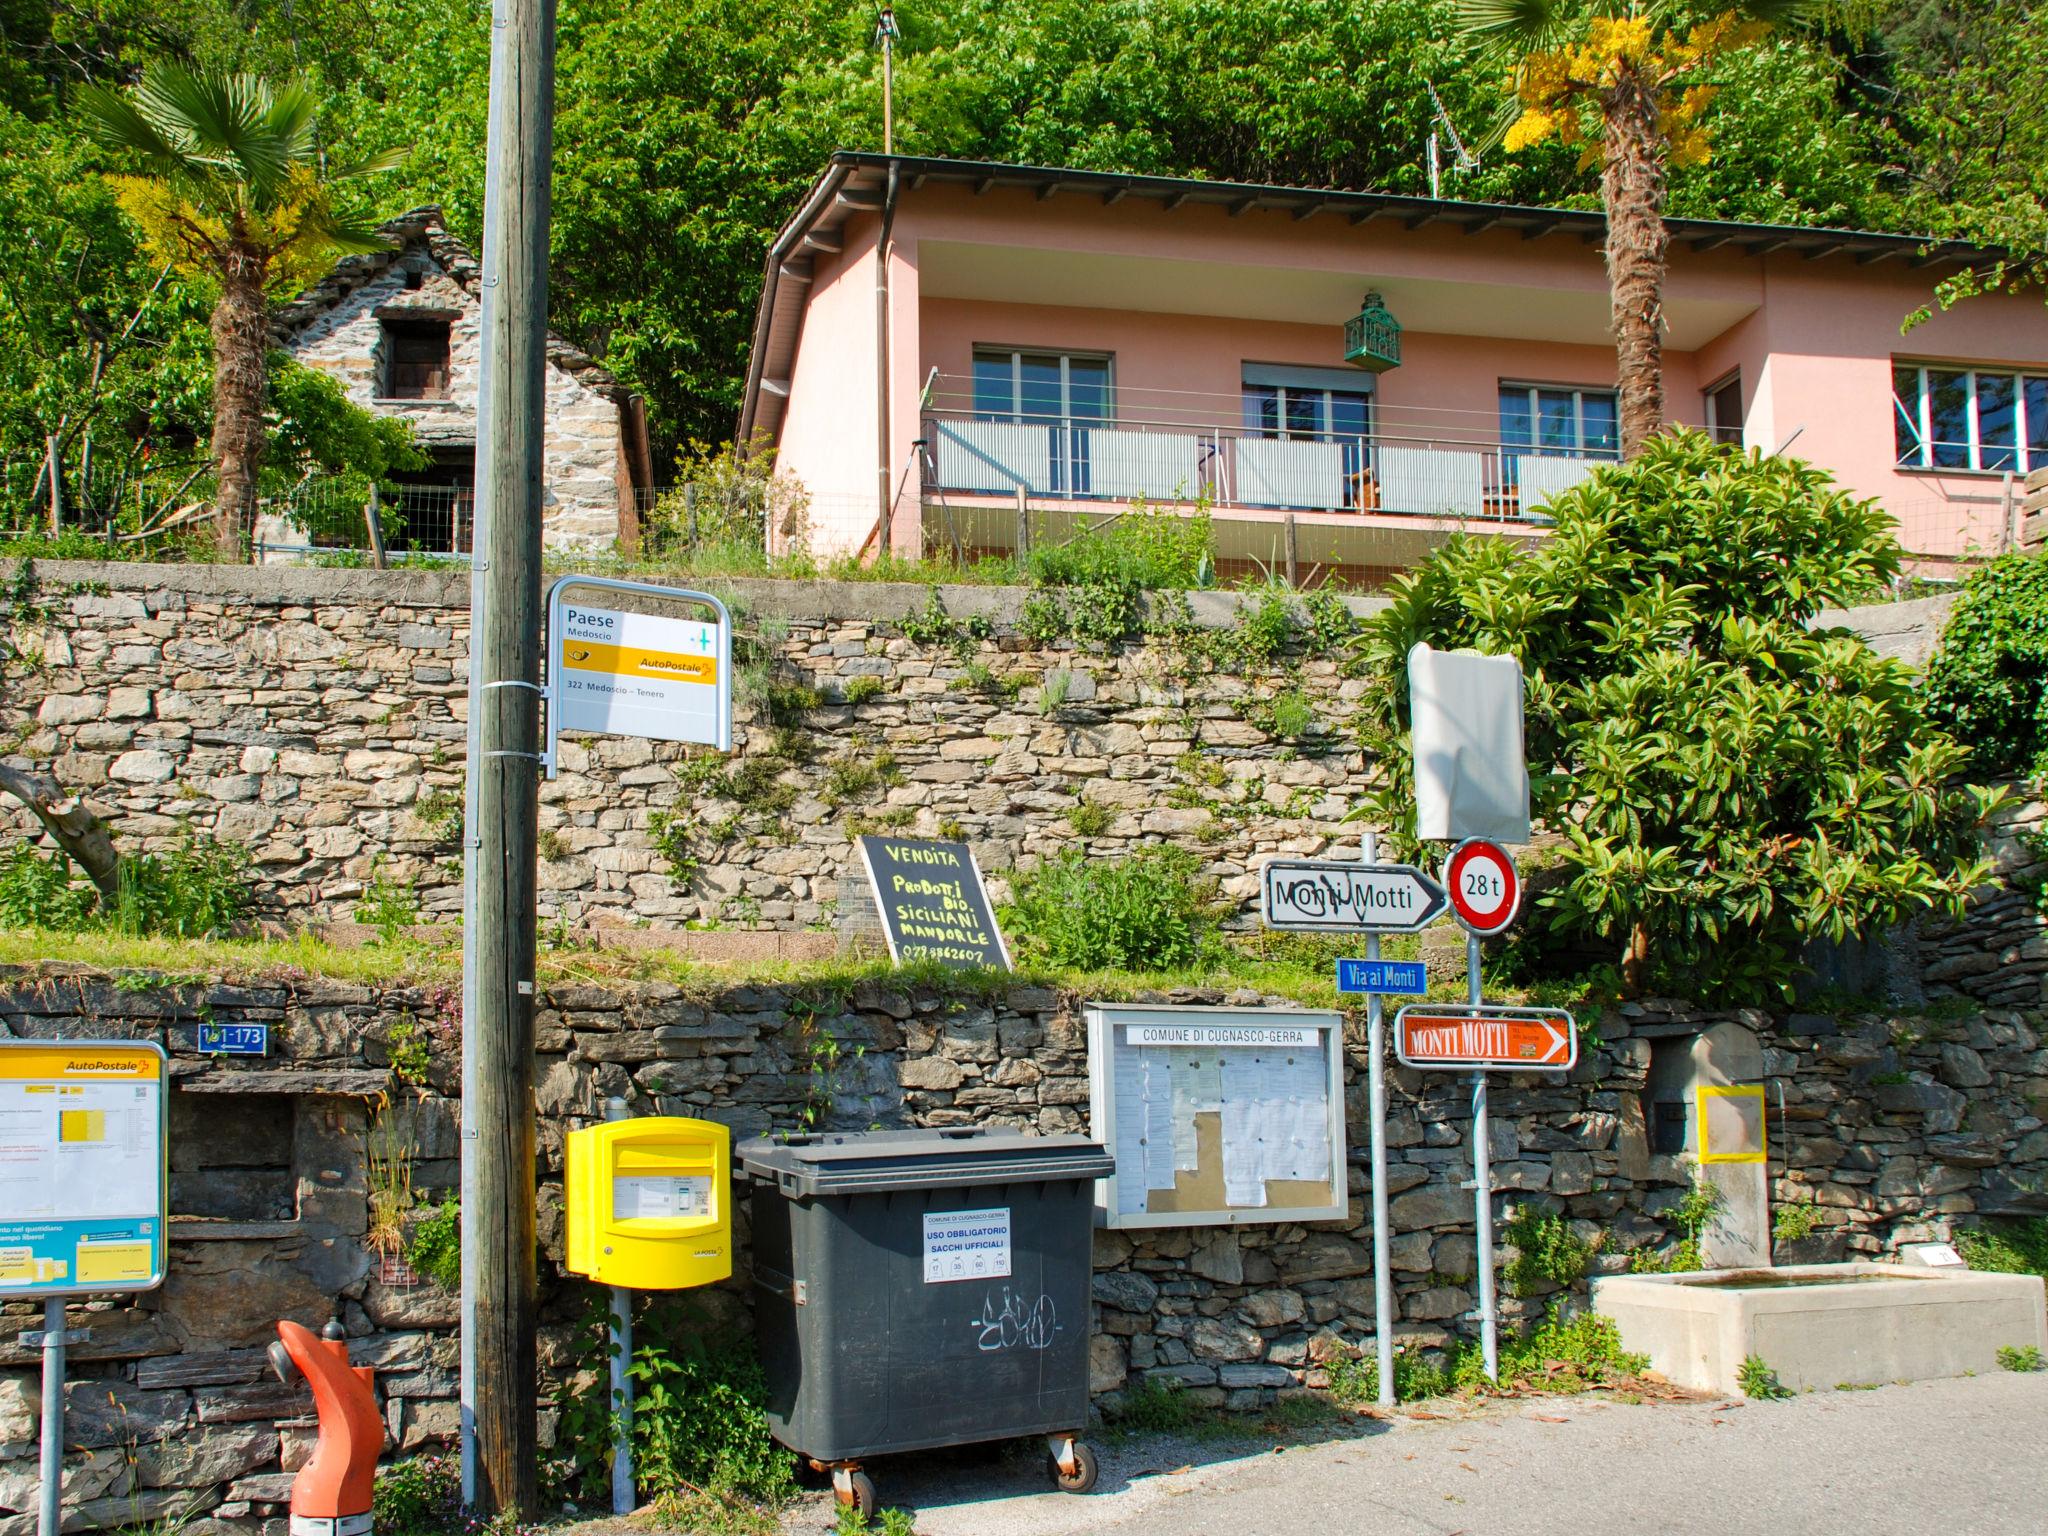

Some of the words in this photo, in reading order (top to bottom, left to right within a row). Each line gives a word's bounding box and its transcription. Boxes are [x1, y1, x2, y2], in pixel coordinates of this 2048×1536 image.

[567, 609, 615, 628] Paese
[567, 627, 612, 641] Medoscio
[640, 658, 701, 673] AutoPostale
[567, 680, 583, 689] 322
[587, 682, 627, 694] Medoscio
[636, 688, 665, 698] Tenero
[1466, 873, 1487, 895] 28
[1491, 877, 1500, 897] t
[1355, 884, 1412, 909] Motti
[1348, 964, 1368, 986] Via
[1369, 968, 1382, 986] ai
[1384, 965, 1416, 987] Monti
[1143, 1029, 1189, 1041] COMUNE
[1193, 1029, 1204, 1041] DI
[1208, 1030, 1303, 1042] CUGNASCO-GERRA
[1410, 1026, 1458, 1056] MONTI
[1460, 1021, 1509, 1057] MOTTI
[66, 1061, 138, 1071] AutoPostale
[927, 1231, 944, 1239] USO
[947, 1226, 1007, 1238] OBBLIGATORIO
[931, 1244, 963, 1253] SACCHI
[964, 1240, 1004, 1250] UFFICIALI
